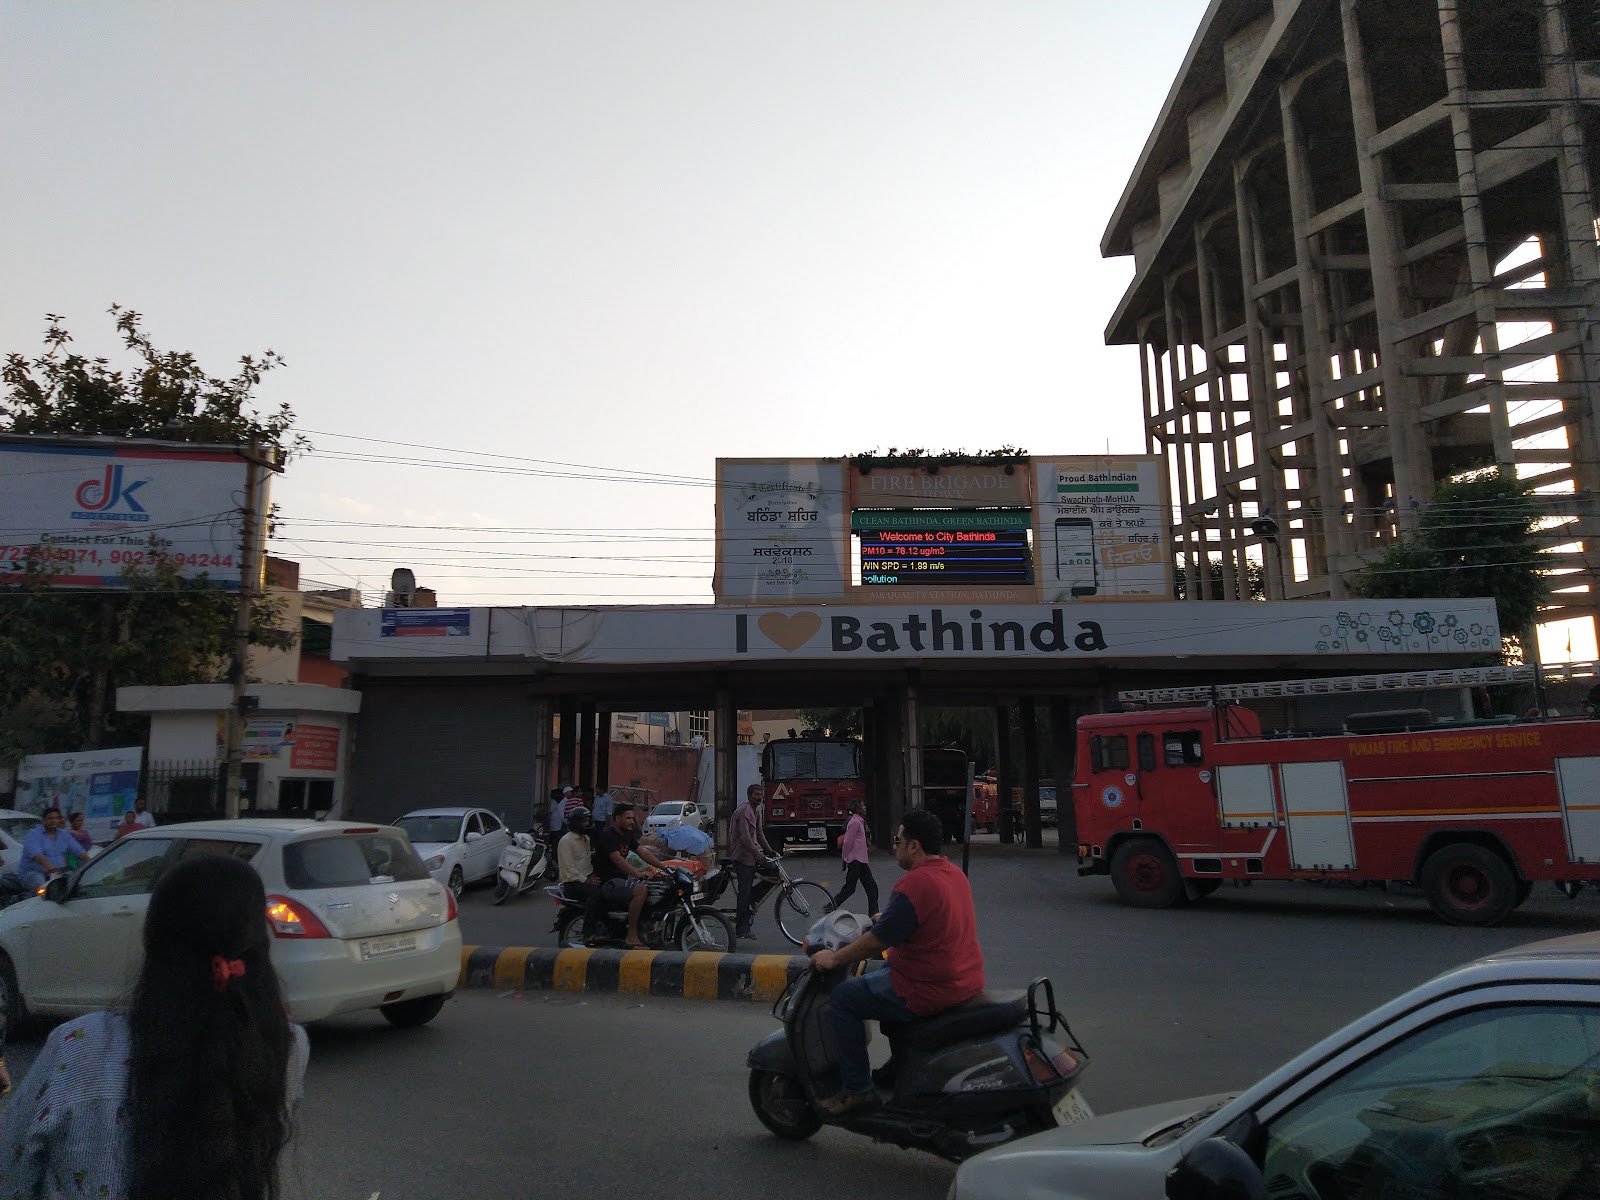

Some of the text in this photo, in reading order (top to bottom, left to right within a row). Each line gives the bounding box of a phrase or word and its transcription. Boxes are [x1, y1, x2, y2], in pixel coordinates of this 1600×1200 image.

[870, 474, 1009, 491] FIRE BRIGADE
[747, 507, 783, 522] ਬਠਿੰਡਾ
[859, 517, 891, 526] CLEAN
[943, 517, 975, 526] GREEN
[976, 517, 1023, 526] BATHINDA
[41, 533, 172, 547] Contact For This ite
[880, 532, 997, 543] Welcome to City Bathinda
[862, 547, 885, 555] PM10
[920, 547, 946, 557] ug/m3
[772, 556, 793, 564] 2018
[881, 561, 900, 570] SPD
[929, 562, 945, 570] m/s
[736, 608, 1108, 653] I Bathinda
[1348, 731, 1542, 757] PUNJAB FIRE AND EMERGENCY SERVICE
